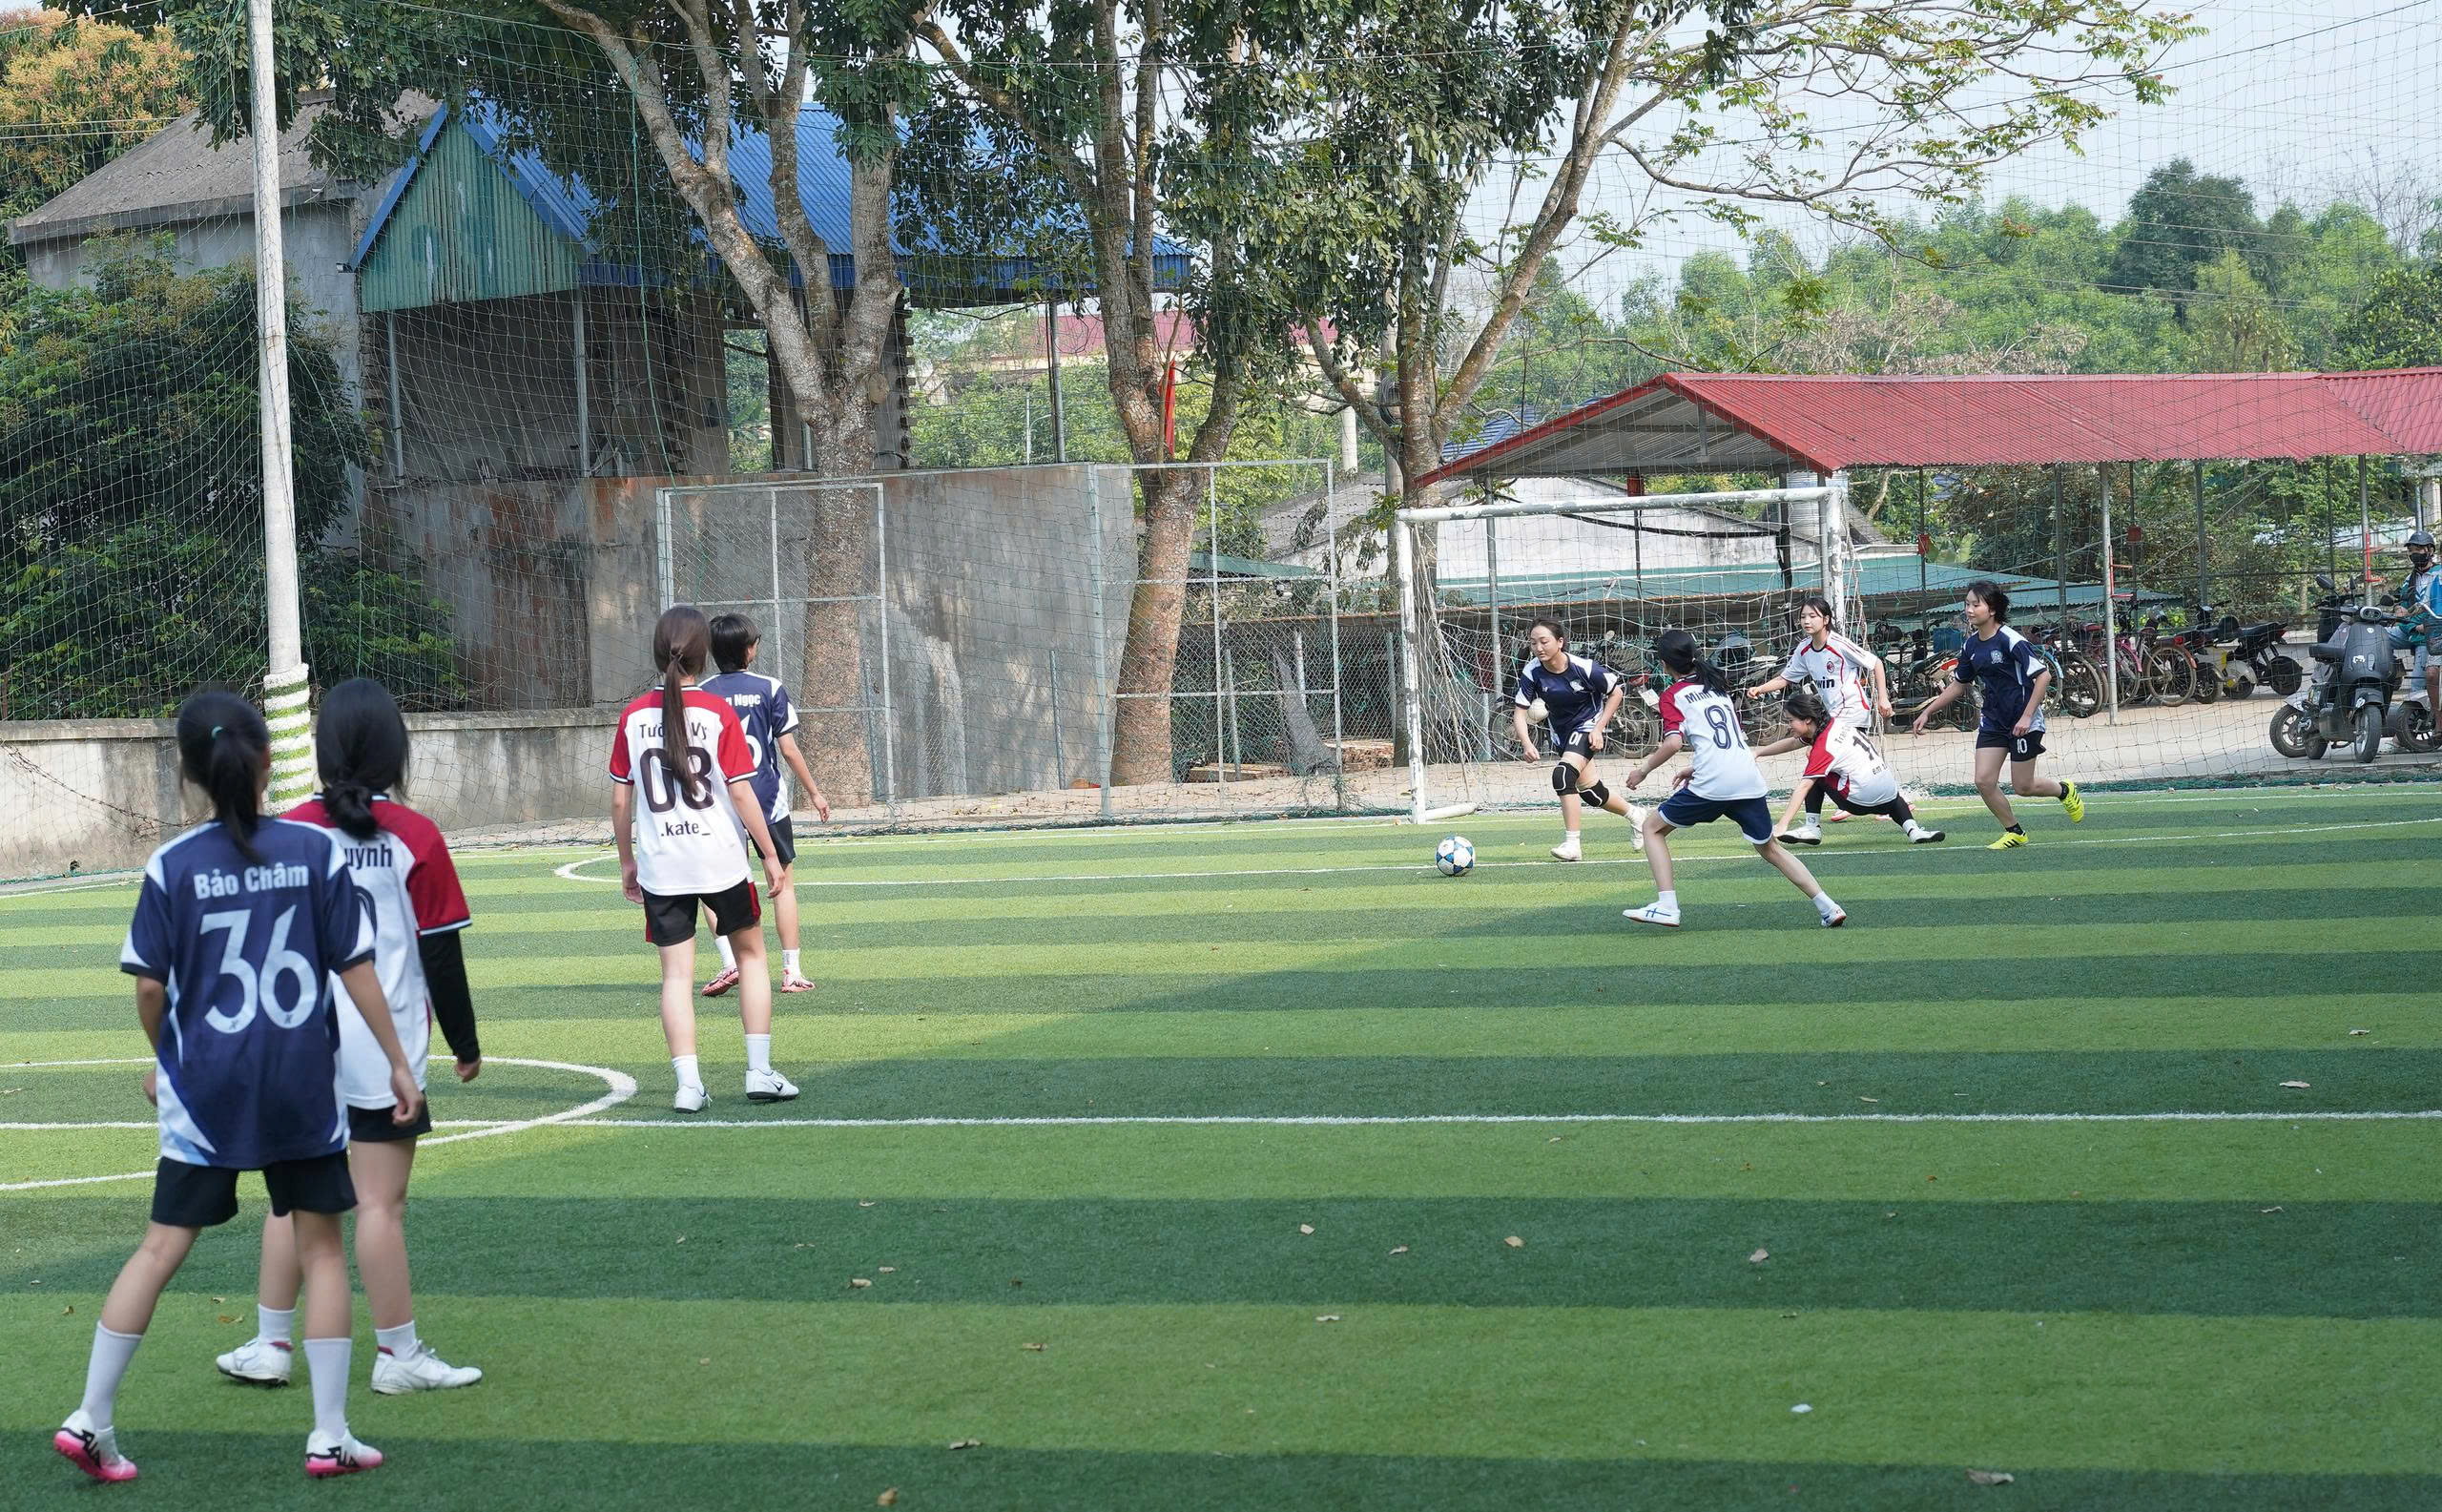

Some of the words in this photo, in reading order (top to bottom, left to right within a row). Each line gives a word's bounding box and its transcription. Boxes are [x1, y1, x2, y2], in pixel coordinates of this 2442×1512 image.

[1816, 676, 1834, 689] win
[734, 694, 761, 707] Ngọc
[1704, 705, 1745, 750] 81
[1568, 731, 1583, 746] 01
[2017, 737, 2028, 754] 10
[639, 747, 714, 813] 08
[660, 820, 712, 837] .kate_
[194, 868, 239, 900] Bảo
[244, 861, 309, 893] Châm
[199, 904, 318, 1034] 36
